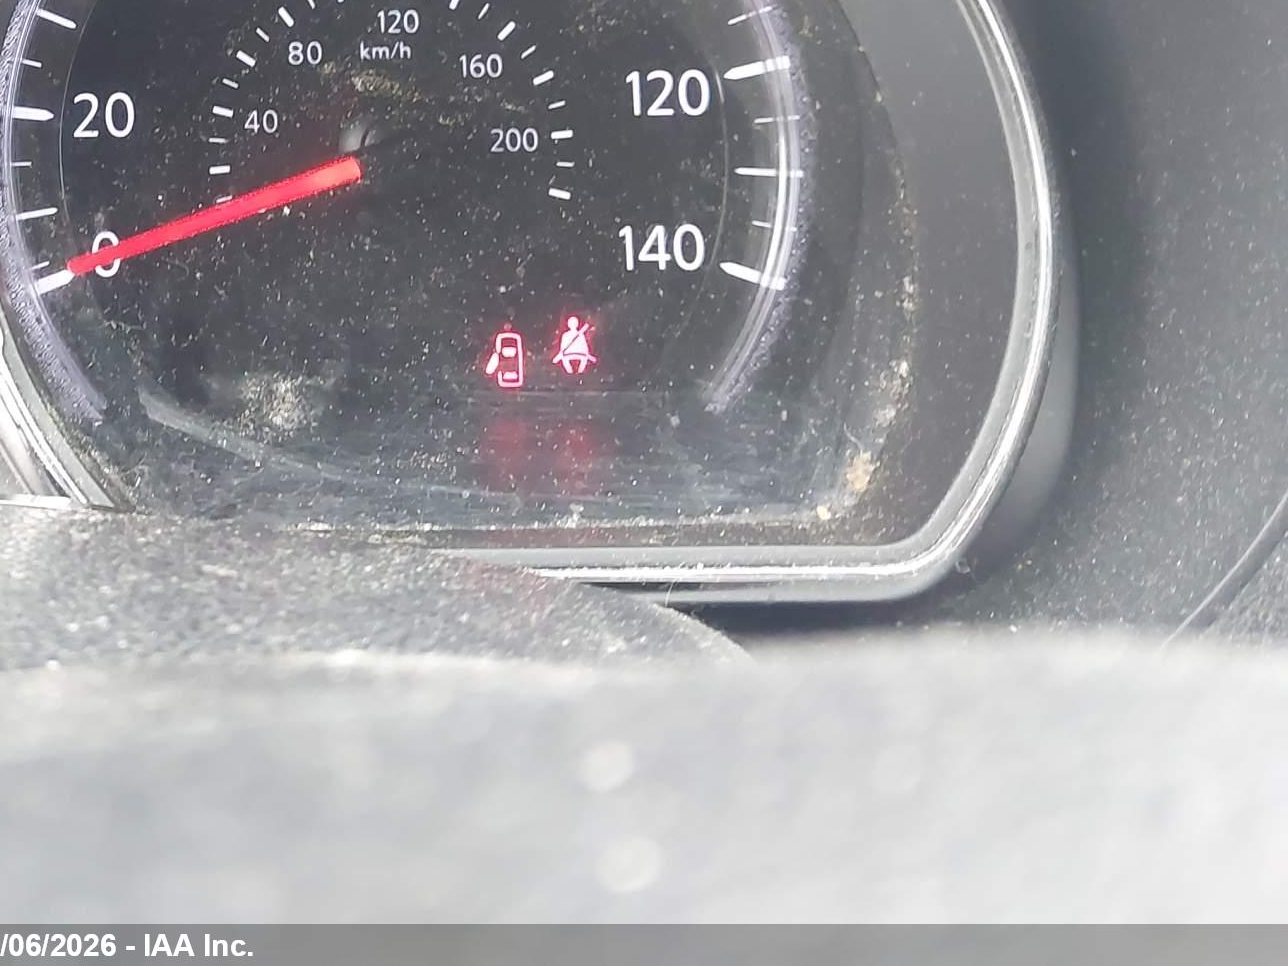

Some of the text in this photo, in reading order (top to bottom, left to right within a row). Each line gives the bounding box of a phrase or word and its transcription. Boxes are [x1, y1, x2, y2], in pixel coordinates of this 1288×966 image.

[378, 10, 418, 34] 120
[288, 42, 323, 65] 80
[360, 41, 411, 61] km/h
[459, 55, 503, 78] 160
[627, 70, 709, 116] 120
[73, 93, 134, 138] 20
[245, 110, 278, 134] 40
[490, 129, 539, 153] 200
[92, 233, 120, 278] 0
[619, 226, 705, 271] 140
